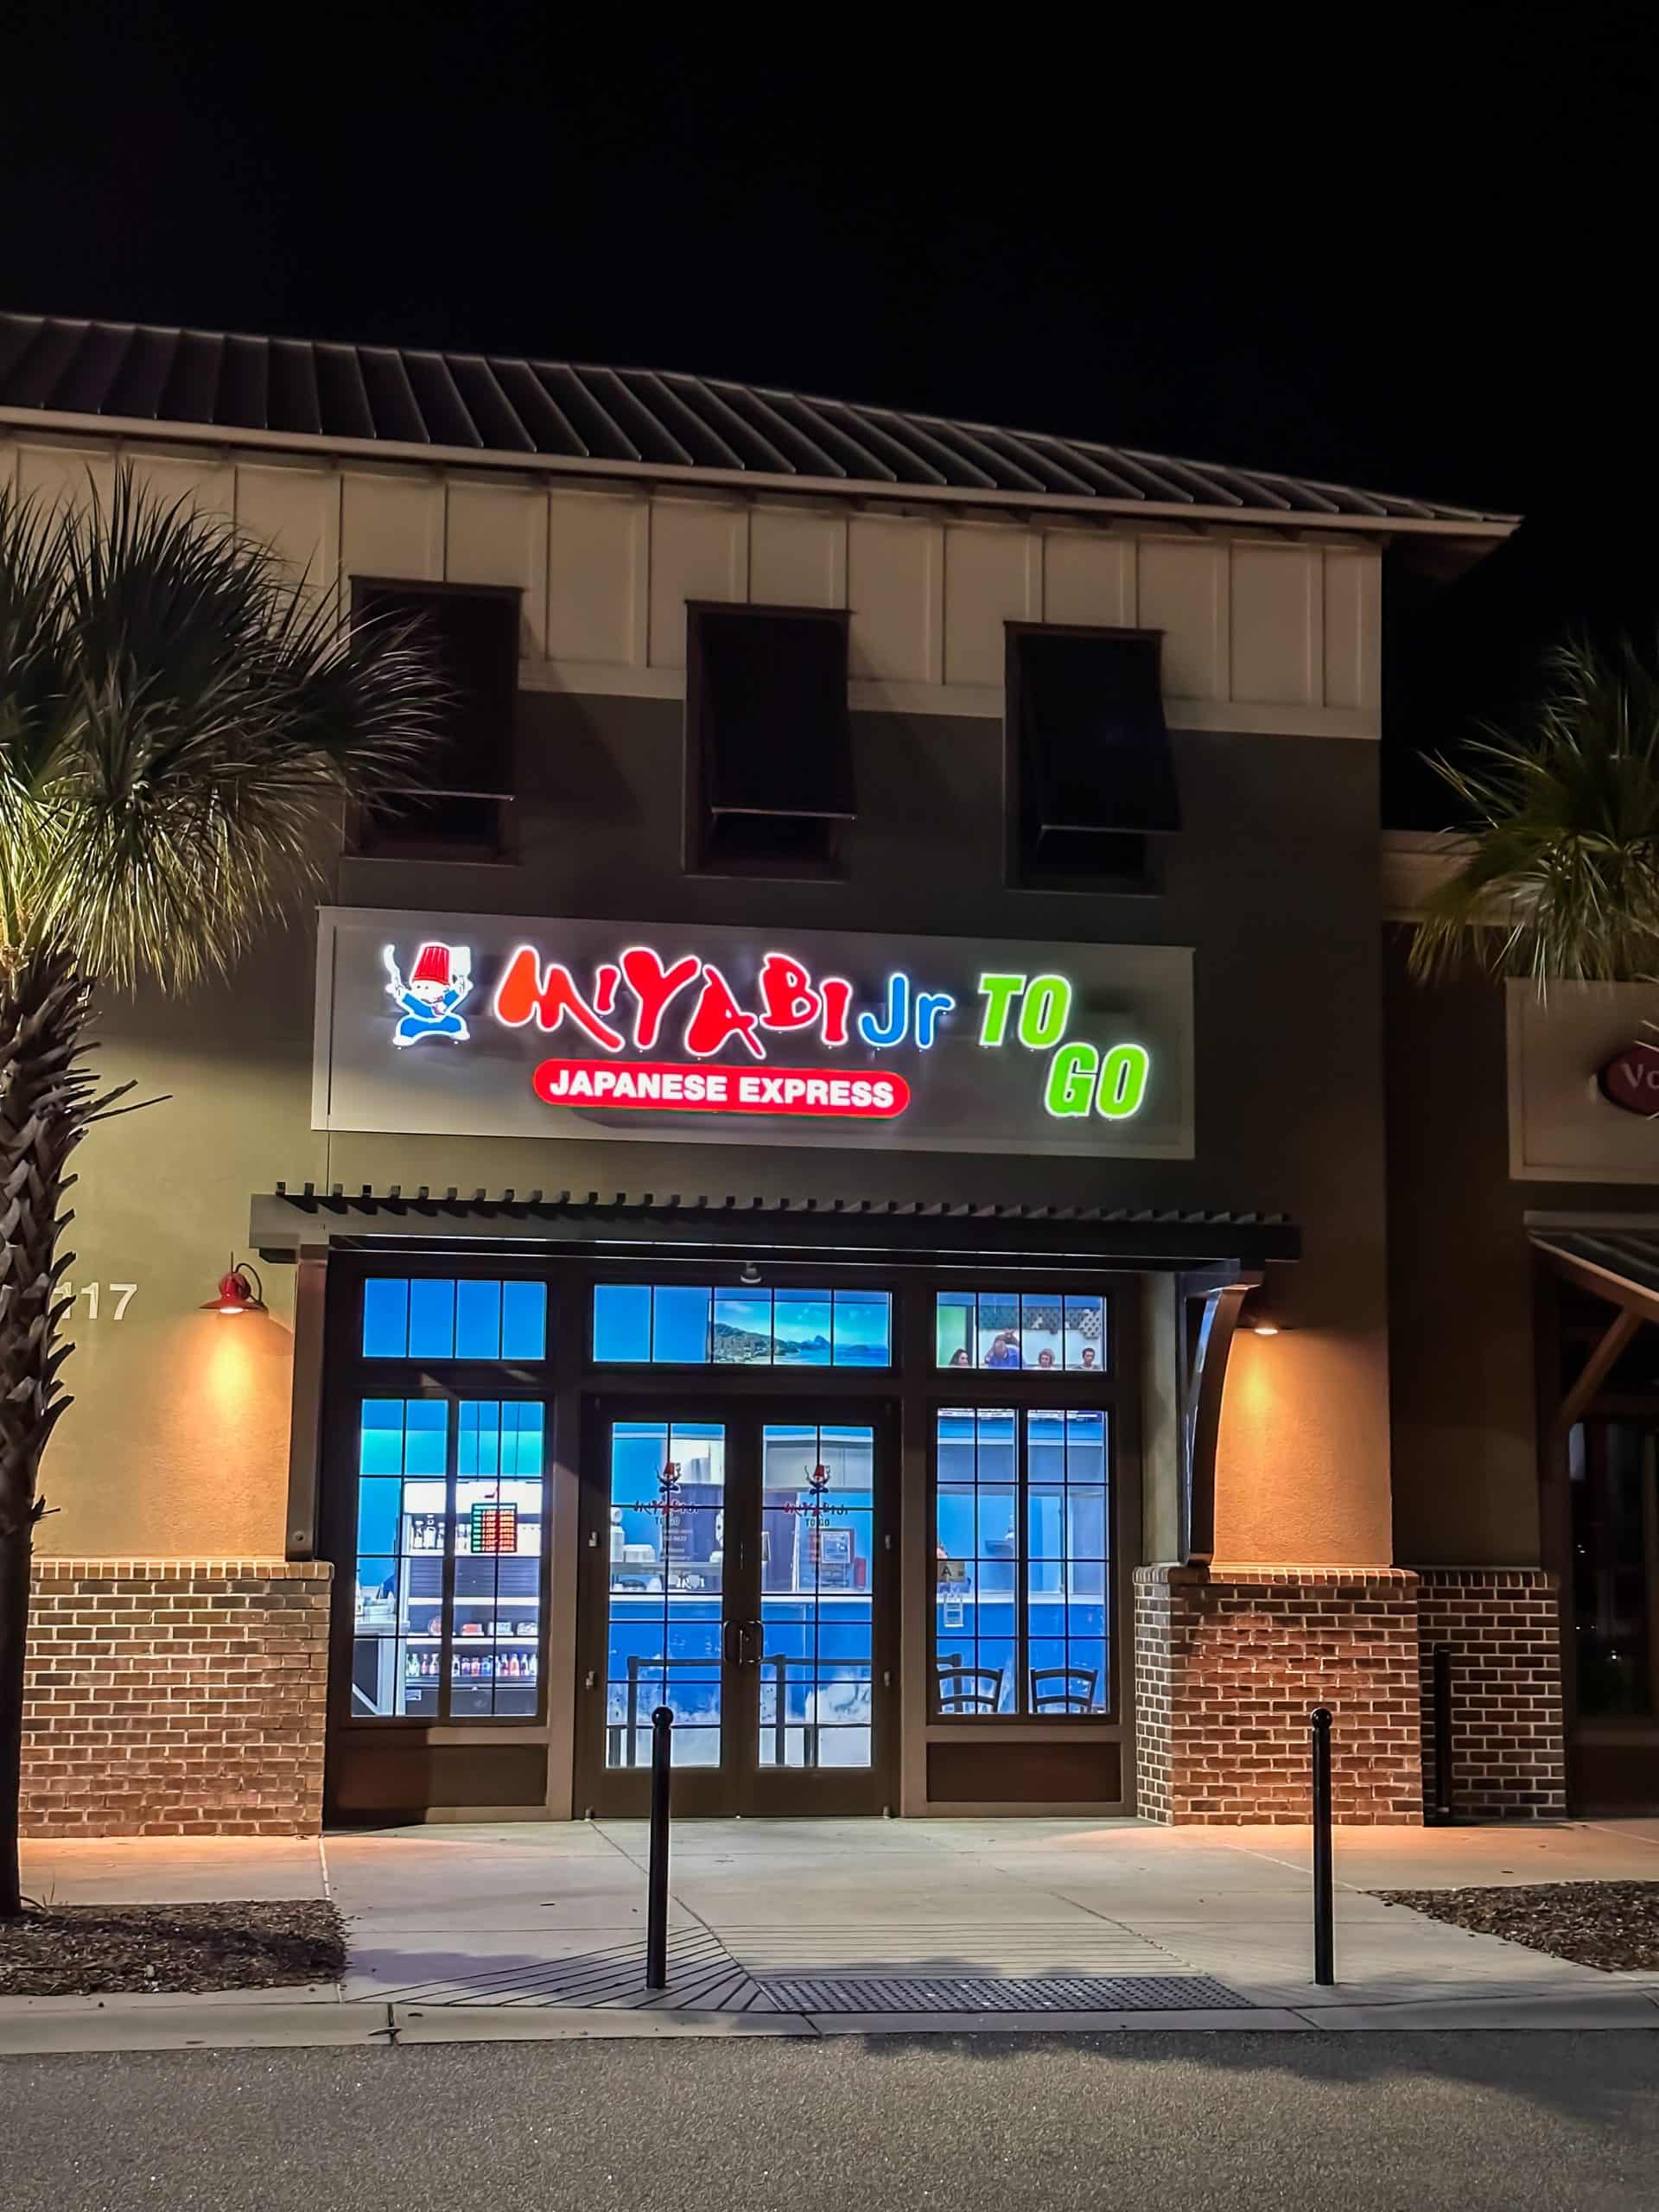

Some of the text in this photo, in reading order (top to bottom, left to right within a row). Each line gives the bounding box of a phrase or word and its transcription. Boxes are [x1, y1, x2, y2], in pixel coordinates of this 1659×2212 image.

[858, 973, 955, 1048] Jr
[978, 973, 1072, 1048] TO
[550, 1070, 895, 1108] JAPANESE EXPRESS
[1045, 1042, 1149, 1119] GO
